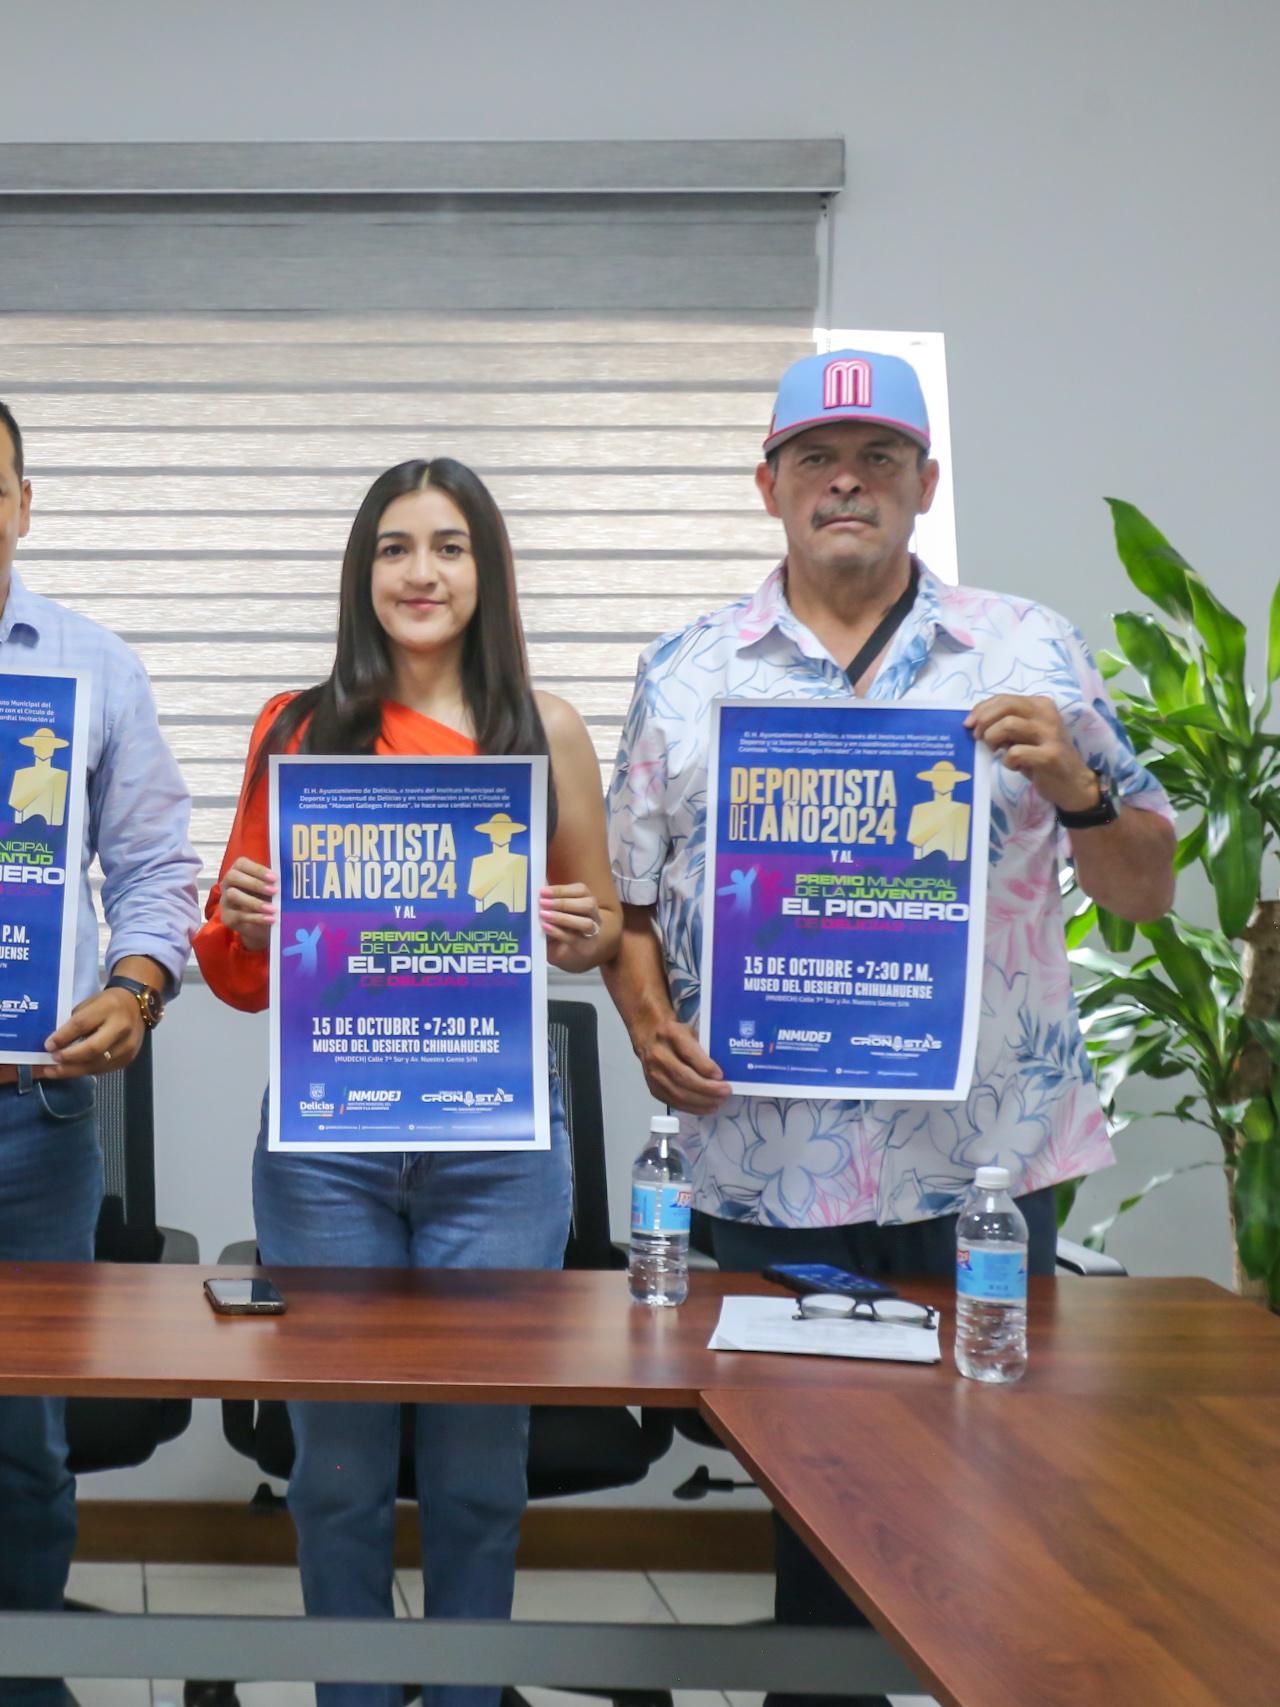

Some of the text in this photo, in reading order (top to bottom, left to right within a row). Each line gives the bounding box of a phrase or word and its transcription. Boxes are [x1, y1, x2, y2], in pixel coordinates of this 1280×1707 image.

[730, 767, 898, 807] DEPORTISTA
[292, 821, 456, 862] DEPORTISTA
[831, 850, 854, 863] Y AL
[795, 874, 957, 889] PREMIO MUNICIPAL
[795, 885, 956, 901] DE LA JUVENTUD
[394, 905, 416, 918] Y AL
[781, 897, 968, 921] EL PIONERO
[2, 924, 30, 943] P.M.
[360, 930, 518, 942] PREMIO MUNICIPAL
[360, 942, 518, 954] DE LA JUVENTUD
[348, 954, 531, 974] EL PIONERO
[744, 956, 763, 974] 15
[767, 957, 785, 975] DE
[789, 957, 852, 978] OCTUBRE
[903, 962, 933, 982] P.M.
[744, 977, 932, 999] MUSEO DEL DESIERTO CHIHUAHUENSE
[312, 1017, 330, 1035] 15
[335, 1017, 353, 1035] DE
[357, 1017, 419, 1035] OCTUBRE
[470, 1017, 499, 1036] P.M.
[312, 1038, 499, 1053] MUSEO DEL DESIERTO CHIHUAHUENSE
[729, 1038, 764, 1048] Delicias
[348, 1090, 401, 1102] INMUDEJ
[299, 1101, 334, 1110] Delicias
